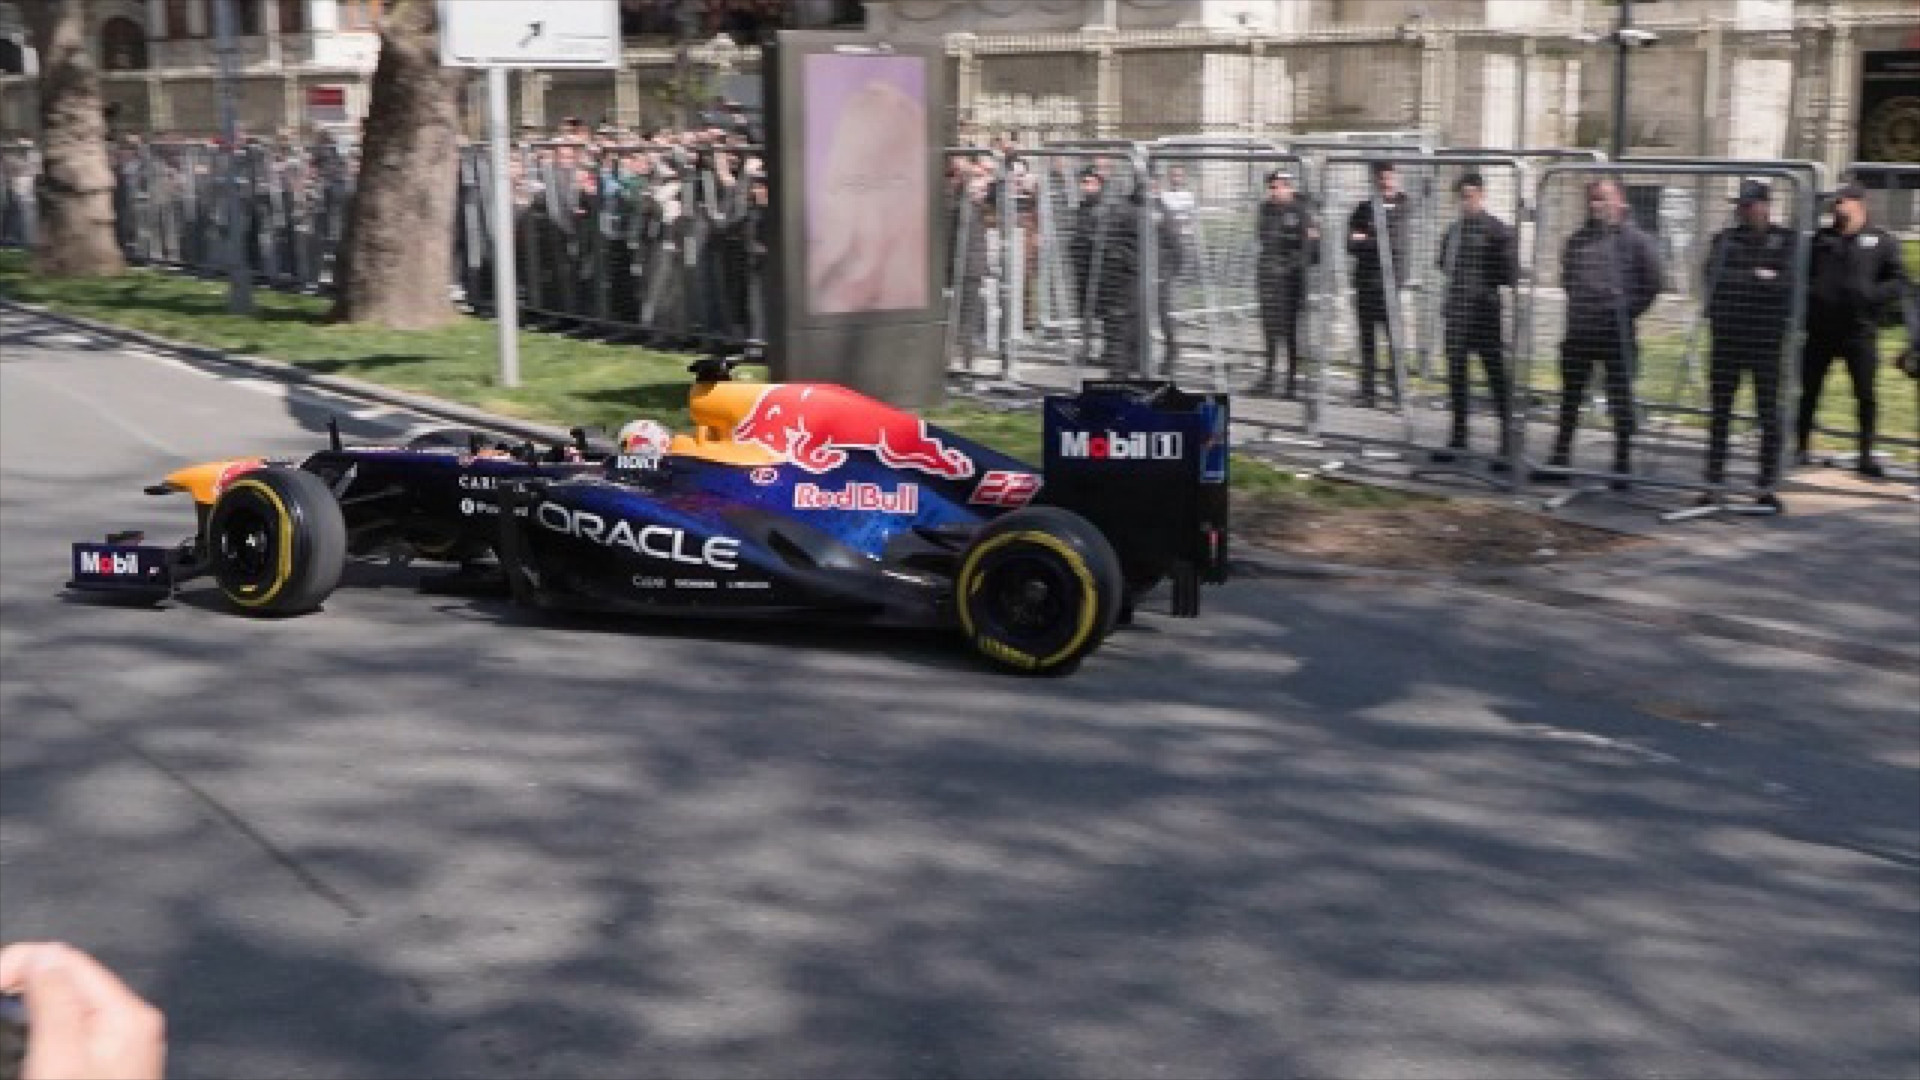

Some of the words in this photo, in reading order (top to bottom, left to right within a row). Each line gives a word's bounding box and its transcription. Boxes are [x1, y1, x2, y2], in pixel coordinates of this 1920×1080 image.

[1061, 430, 1147, 460] Mobil
[793, 482, 853, 509] Red
[856, 482, 919, 513] Bull
[969, 471, 1044, 504] 22
[537, 501, 741, 570] ORACLE
[80, 552, 139, 575] Mobil
